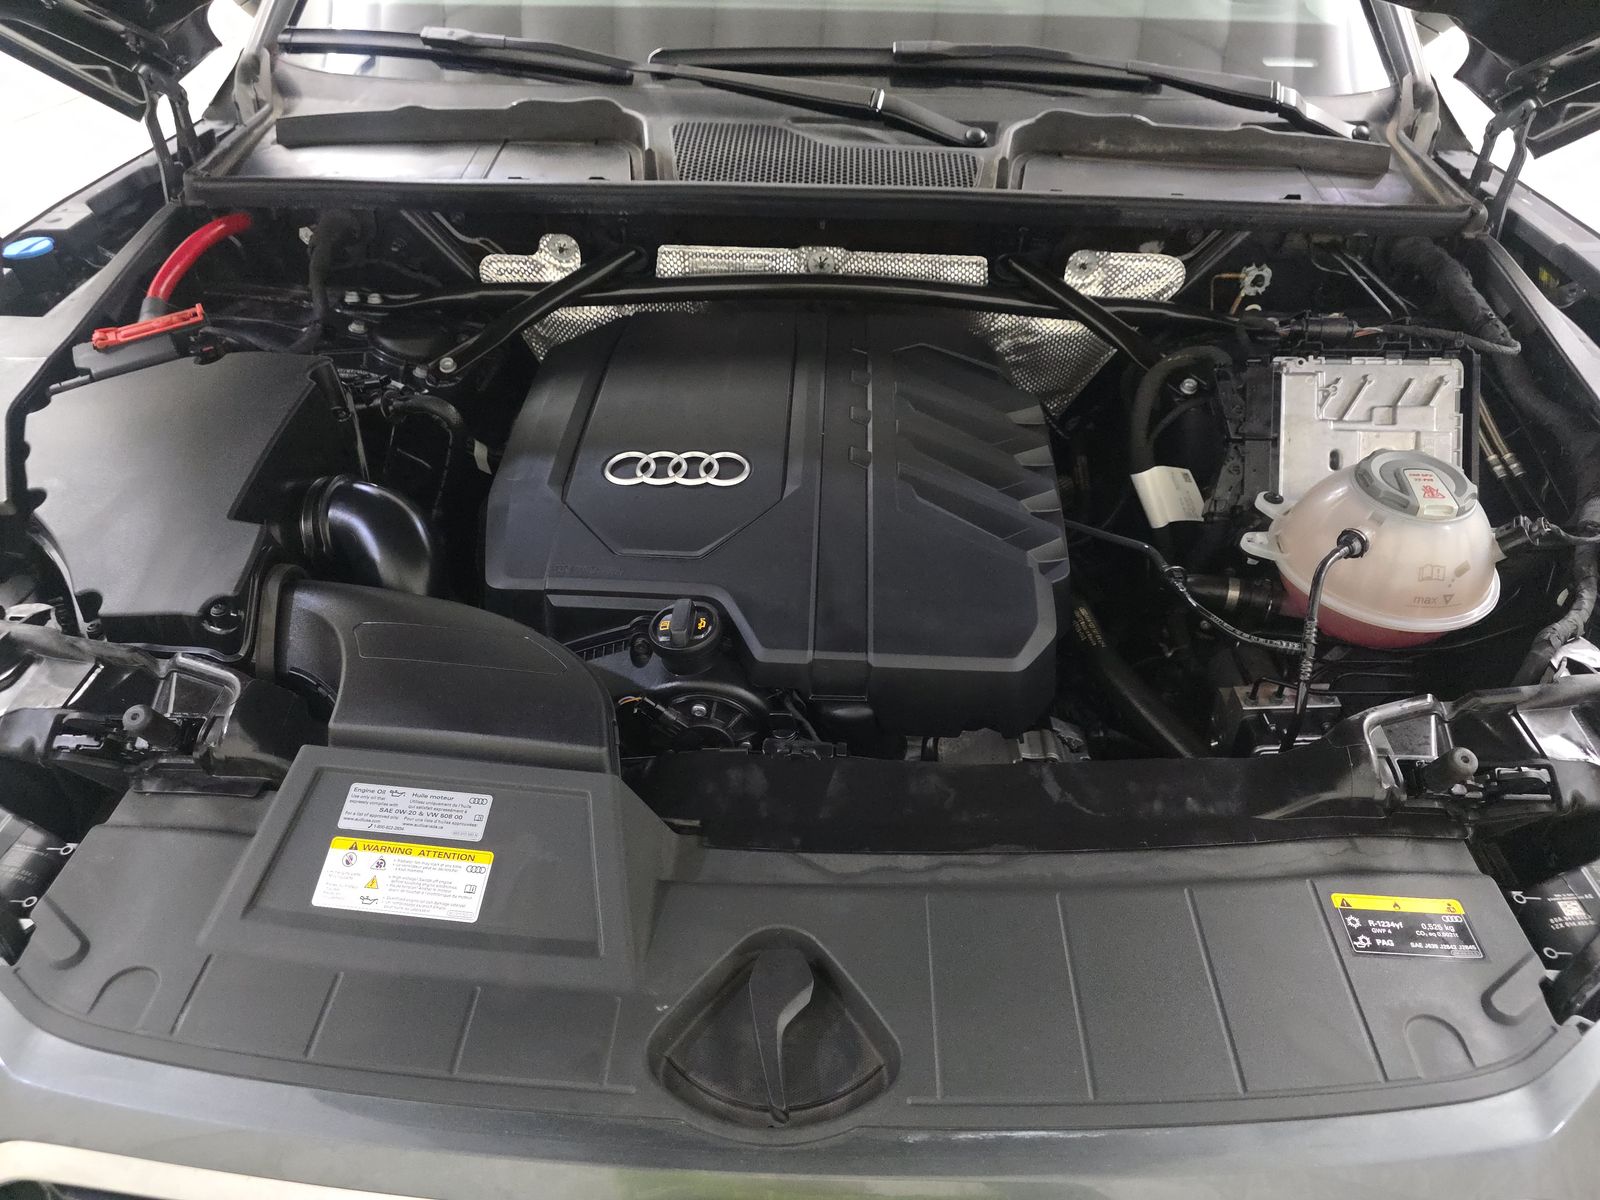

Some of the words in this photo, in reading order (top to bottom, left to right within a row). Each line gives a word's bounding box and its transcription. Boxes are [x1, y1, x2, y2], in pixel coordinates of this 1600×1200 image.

[1412, 596, 1439, 604] max
[363, 844, 413, 855] WARNING
[418, 850, 475, 862] ATTENTION
[1368, 920, 1404, 930] R-1234yf
[1445, 924, 1455, 932] kg
[1375, 939, 1394, 947] PAG
